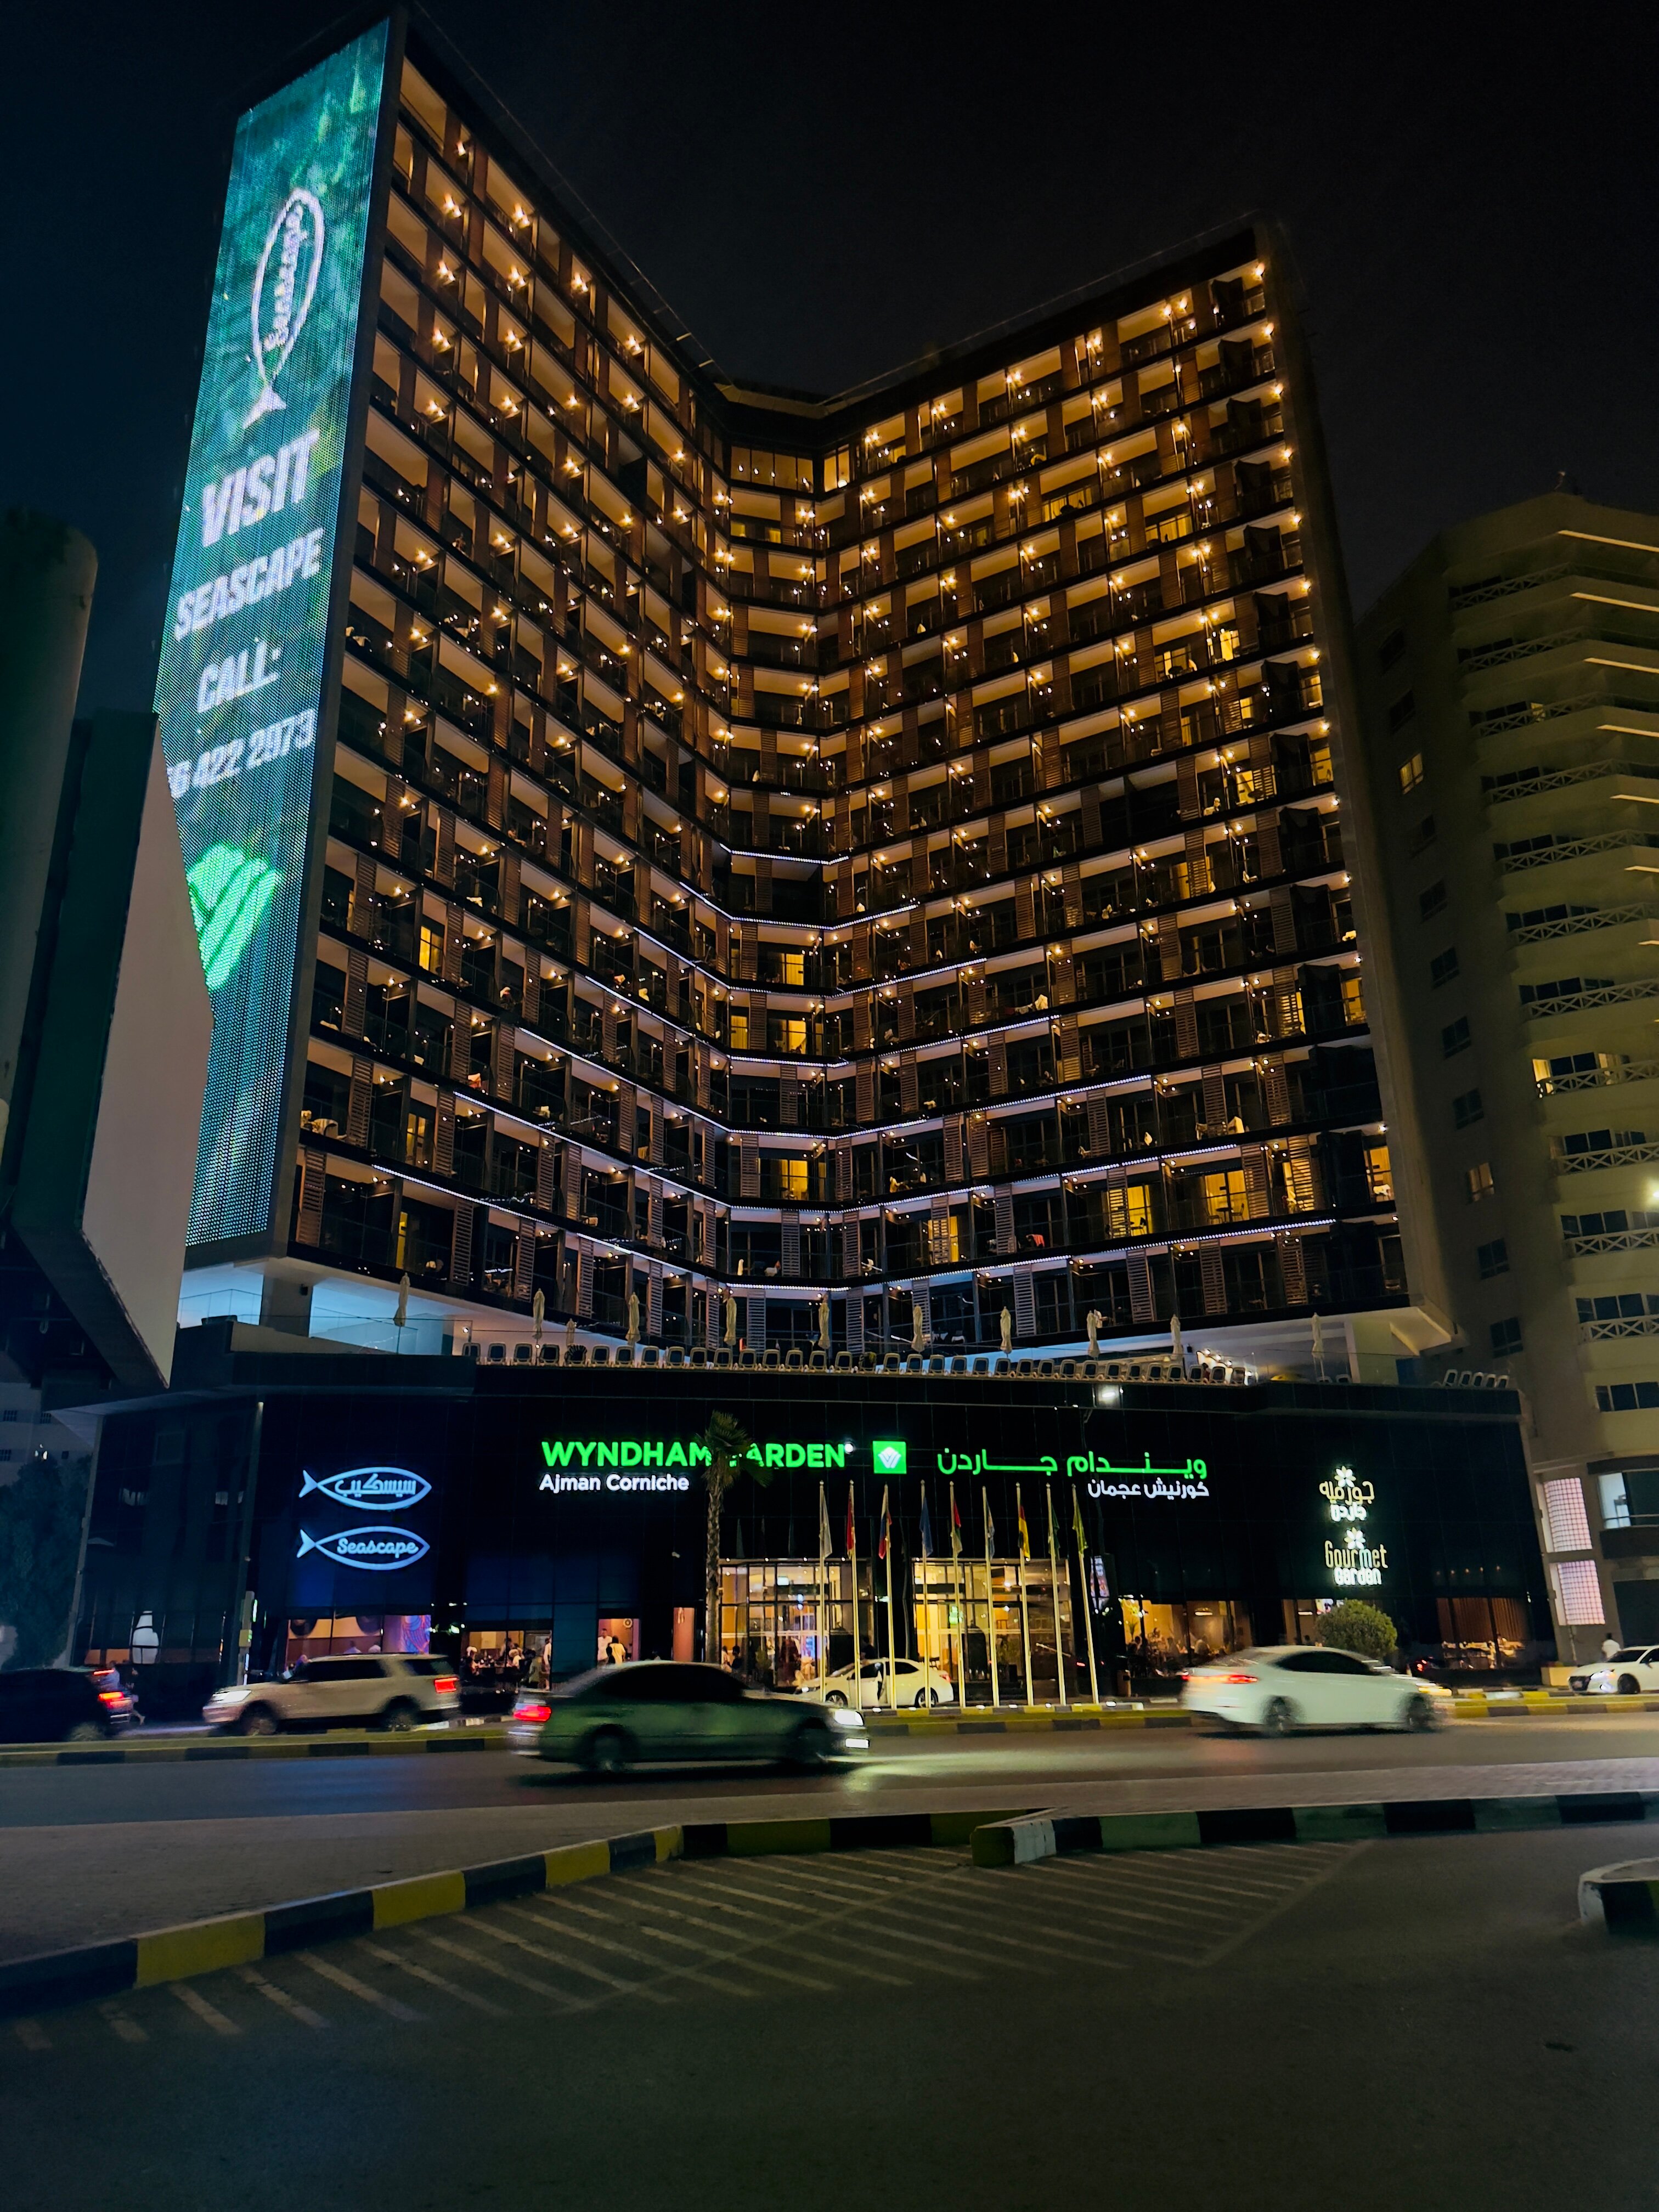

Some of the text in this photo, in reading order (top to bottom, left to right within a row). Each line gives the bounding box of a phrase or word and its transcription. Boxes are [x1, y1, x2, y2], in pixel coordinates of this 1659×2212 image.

[202, 428, 320, 548] VISIT
[174, 527, 324, 641] SEASCAPE
[196, 639, 281, 714] CALL:
[191, 737, 246, 787] 422
[541, 1441, 845, 1468] WYNDHAM ARDEN
[334, 1473, 416, 1498] سيسكيب
[539, 1473, 690, 1493] Ajman Corniche
[1088, 1477, 1210, 1500] كورنيش عجمان
[337, 1538, 419, 1559] Seascape
[1325, 1540, 1388, 1568] Gourmet
[1334, 1566, 1382, 1585] Garden
